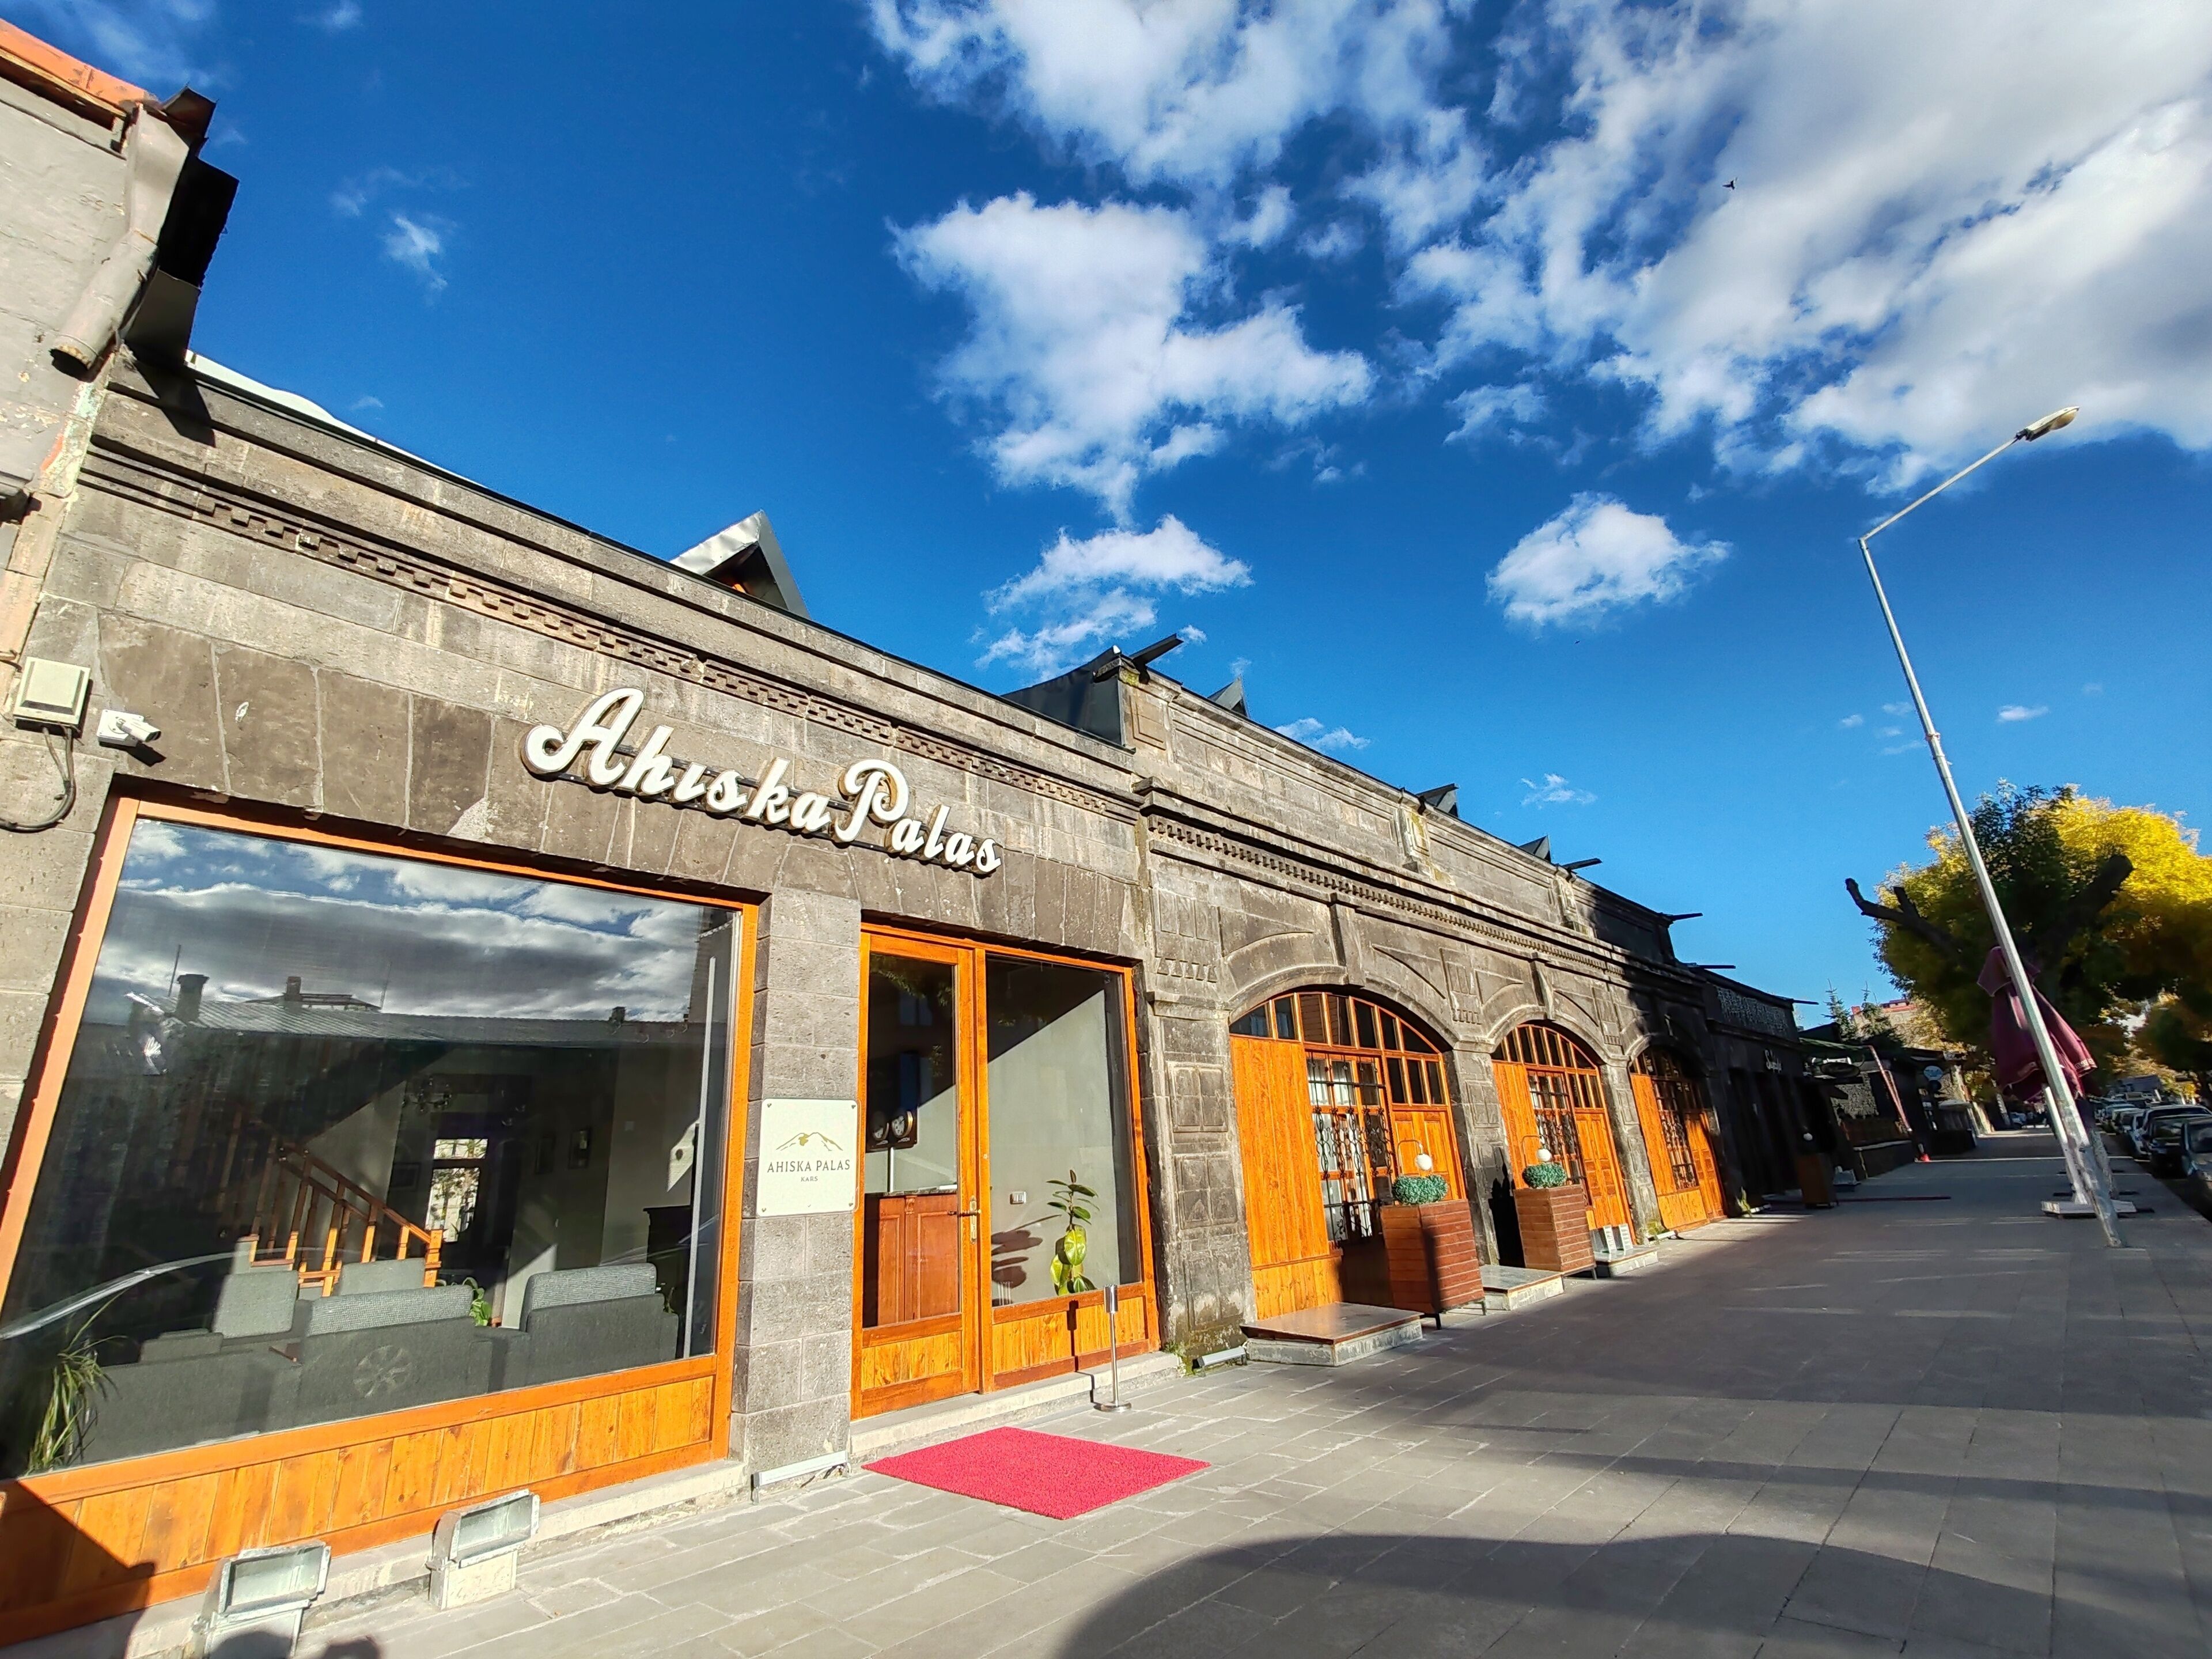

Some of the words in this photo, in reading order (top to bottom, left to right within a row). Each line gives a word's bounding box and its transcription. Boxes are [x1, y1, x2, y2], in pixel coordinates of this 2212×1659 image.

[835, 759, 1001, 873] Palas
[767, 1161, 812, 1173] AHISKA
[816, 1159, 850, 1171] PALAS
